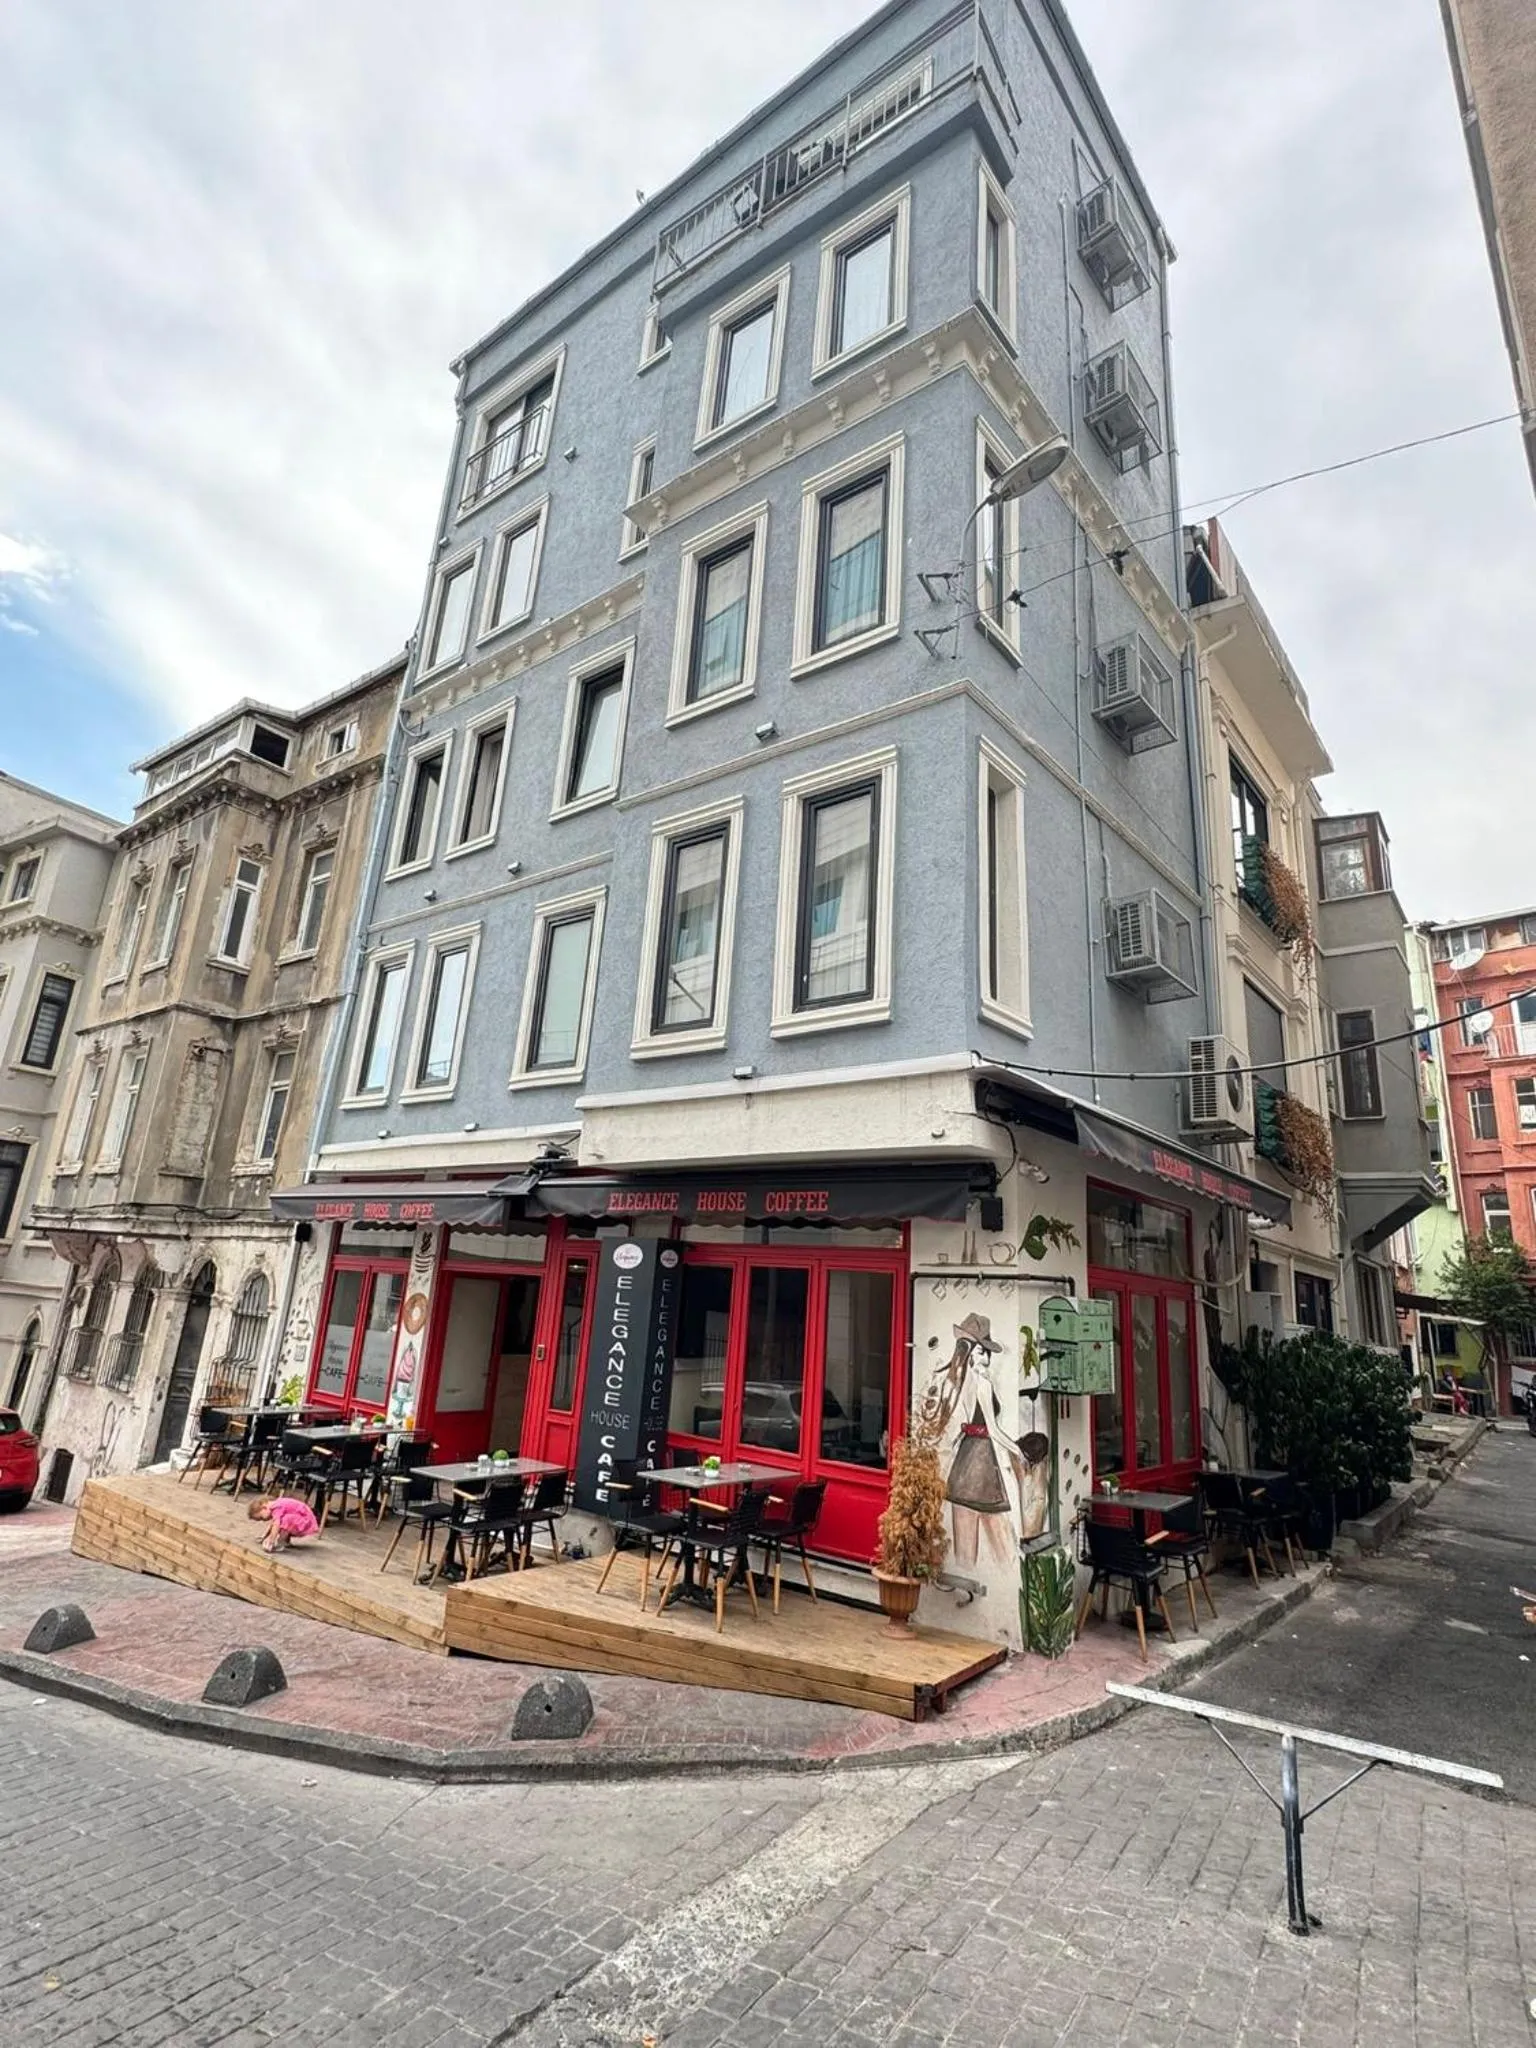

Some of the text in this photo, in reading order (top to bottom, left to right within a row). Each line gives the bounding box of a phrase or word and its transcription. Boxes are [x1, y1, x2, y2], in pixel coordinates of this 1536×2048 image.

[608, 1191, 829, 1212] ELEGANCE HOUSE COFFEE
[604, 1275, 633, 1407] ELEGANCE
[650, 1278, 673, 1410] ELEGANCE
[590, 1410, 631, 1430] HOUSE
[595, 1435, 616, 1502] CAFE
